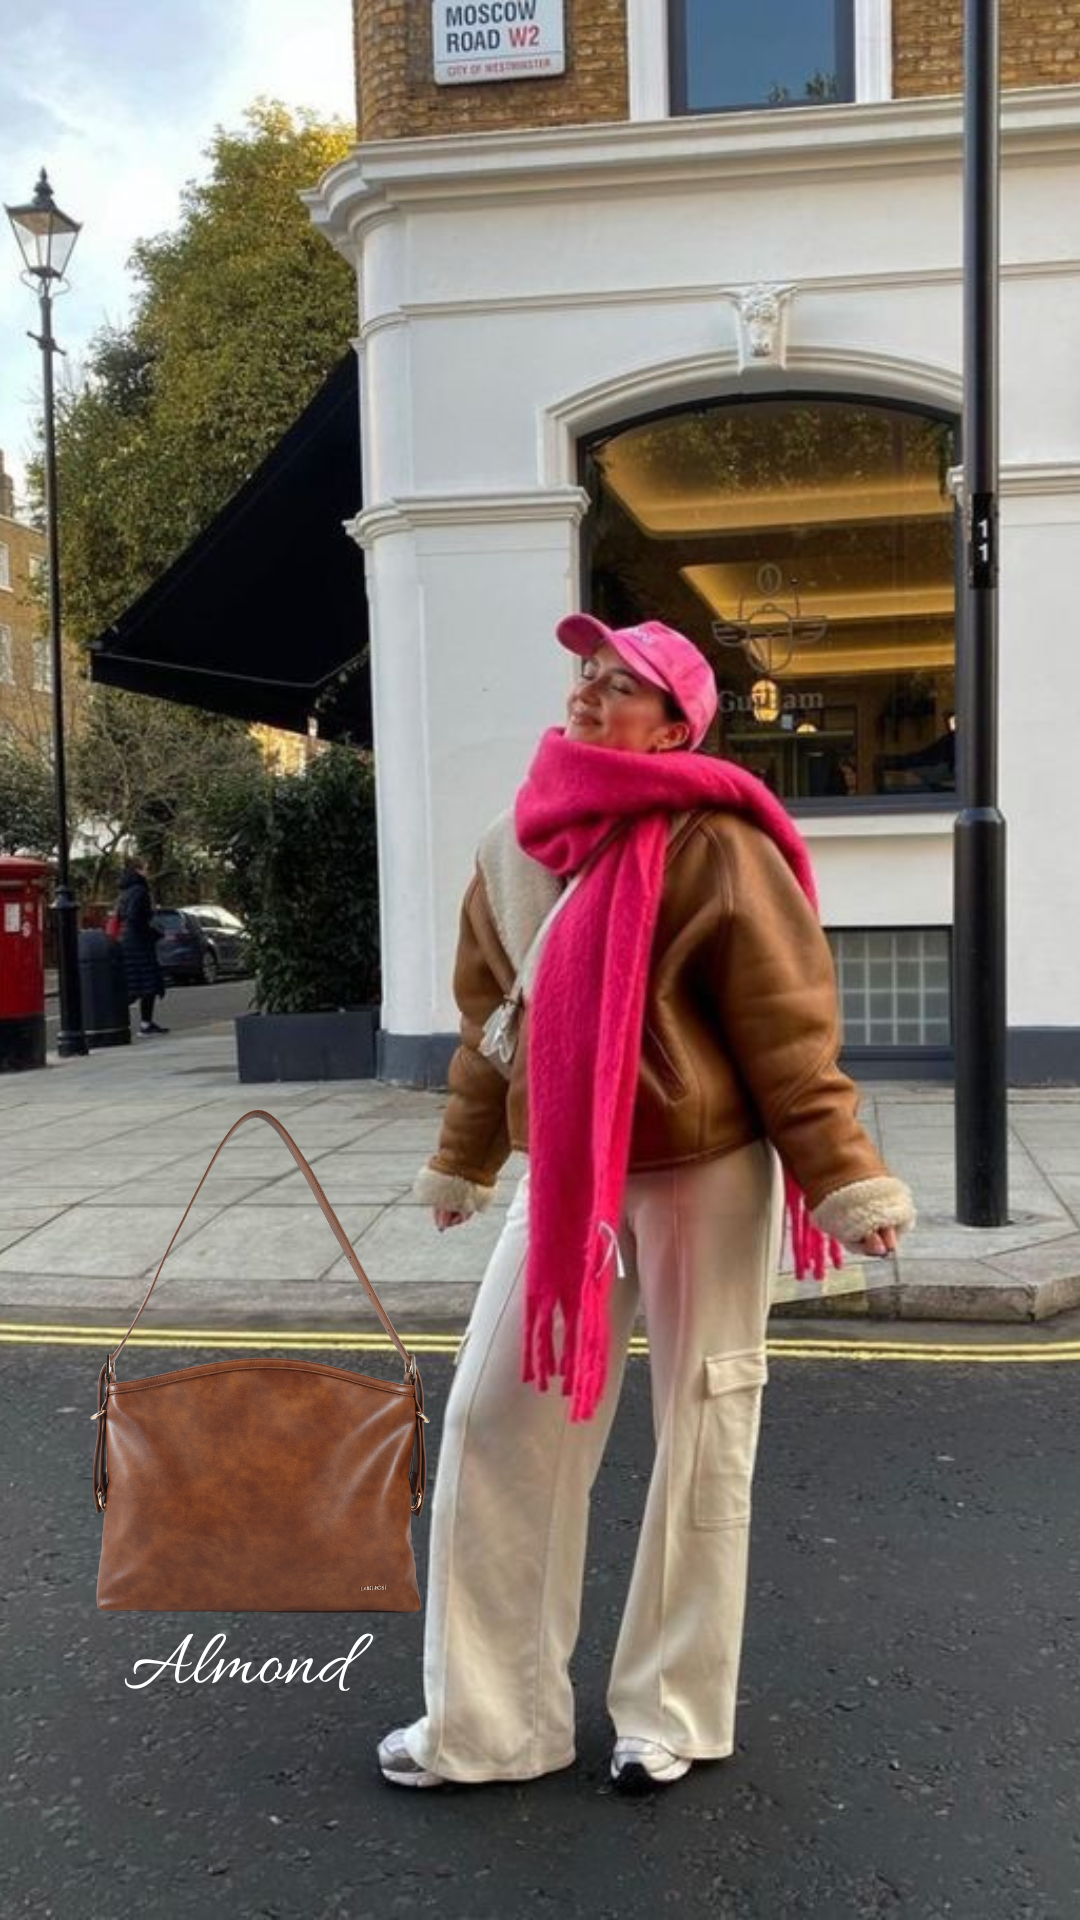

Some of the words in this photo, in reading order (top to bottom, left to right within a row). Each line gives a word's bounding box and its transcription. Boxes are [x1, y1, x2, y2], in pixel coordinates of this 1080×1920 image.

[446, 0, 536, 27] MOSCOW
[446, 29, 500, 53] ROAD
[508, 25, 540, 48] W2
[448, 65, 467, 77] CITY
[469, 64, 481, 75] OF
